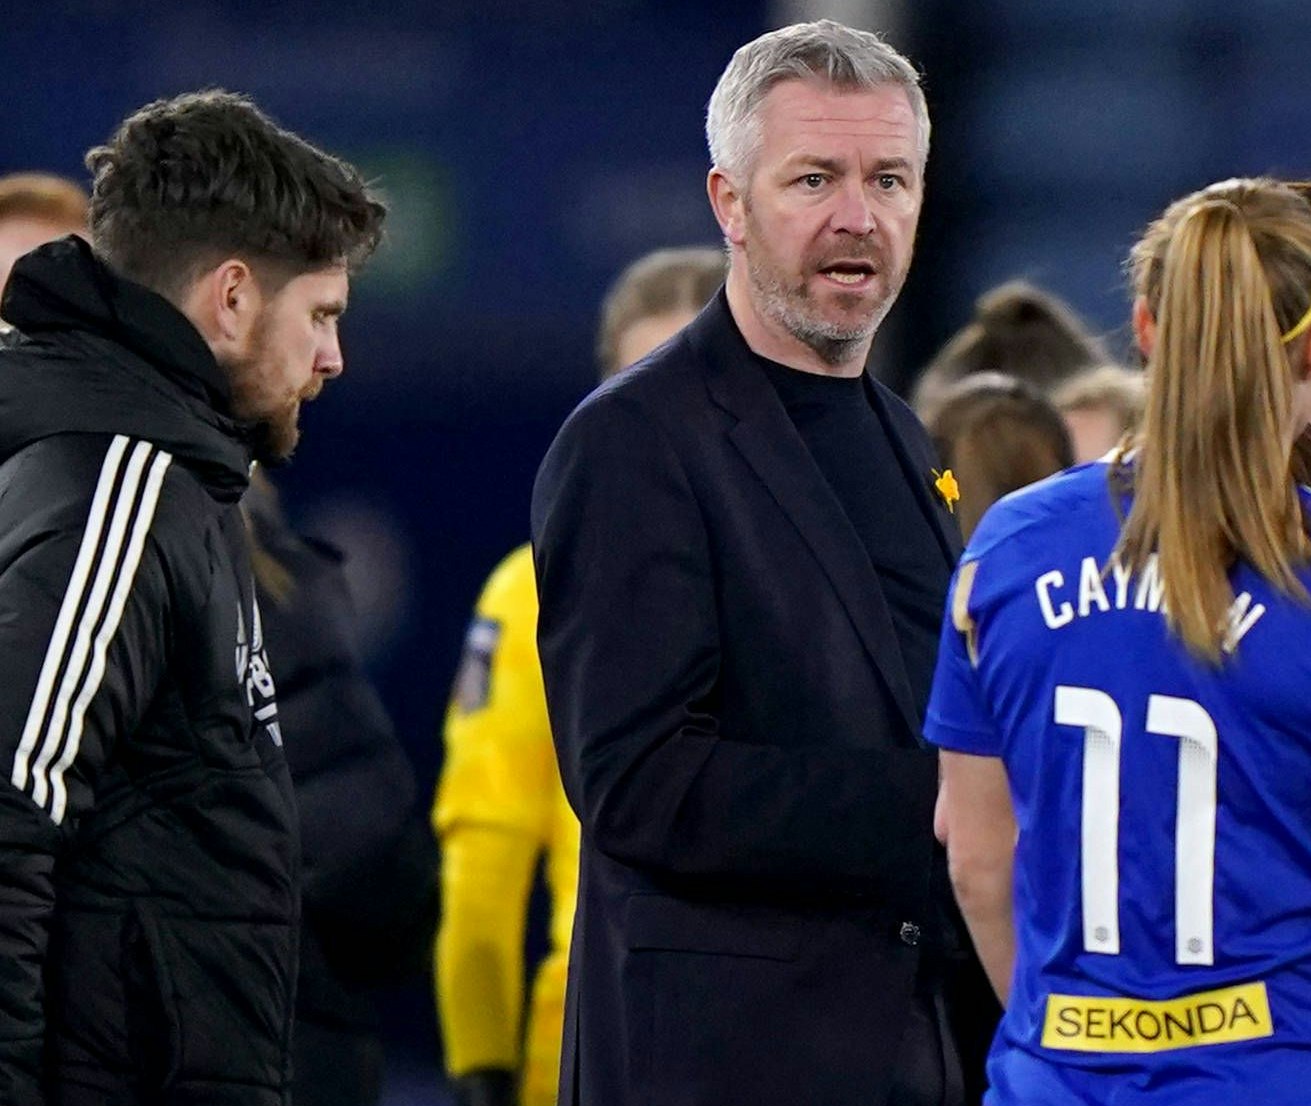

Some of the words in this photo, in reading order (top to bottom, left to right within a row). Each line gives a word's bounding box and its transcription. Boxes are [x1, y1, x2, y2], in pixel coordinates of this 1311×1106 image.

[1035, 553, 1266, 654] CAYMN
[1053, 686, 1219, 966] 11
[1055, 997, 1260, 1042] SEKONDA
